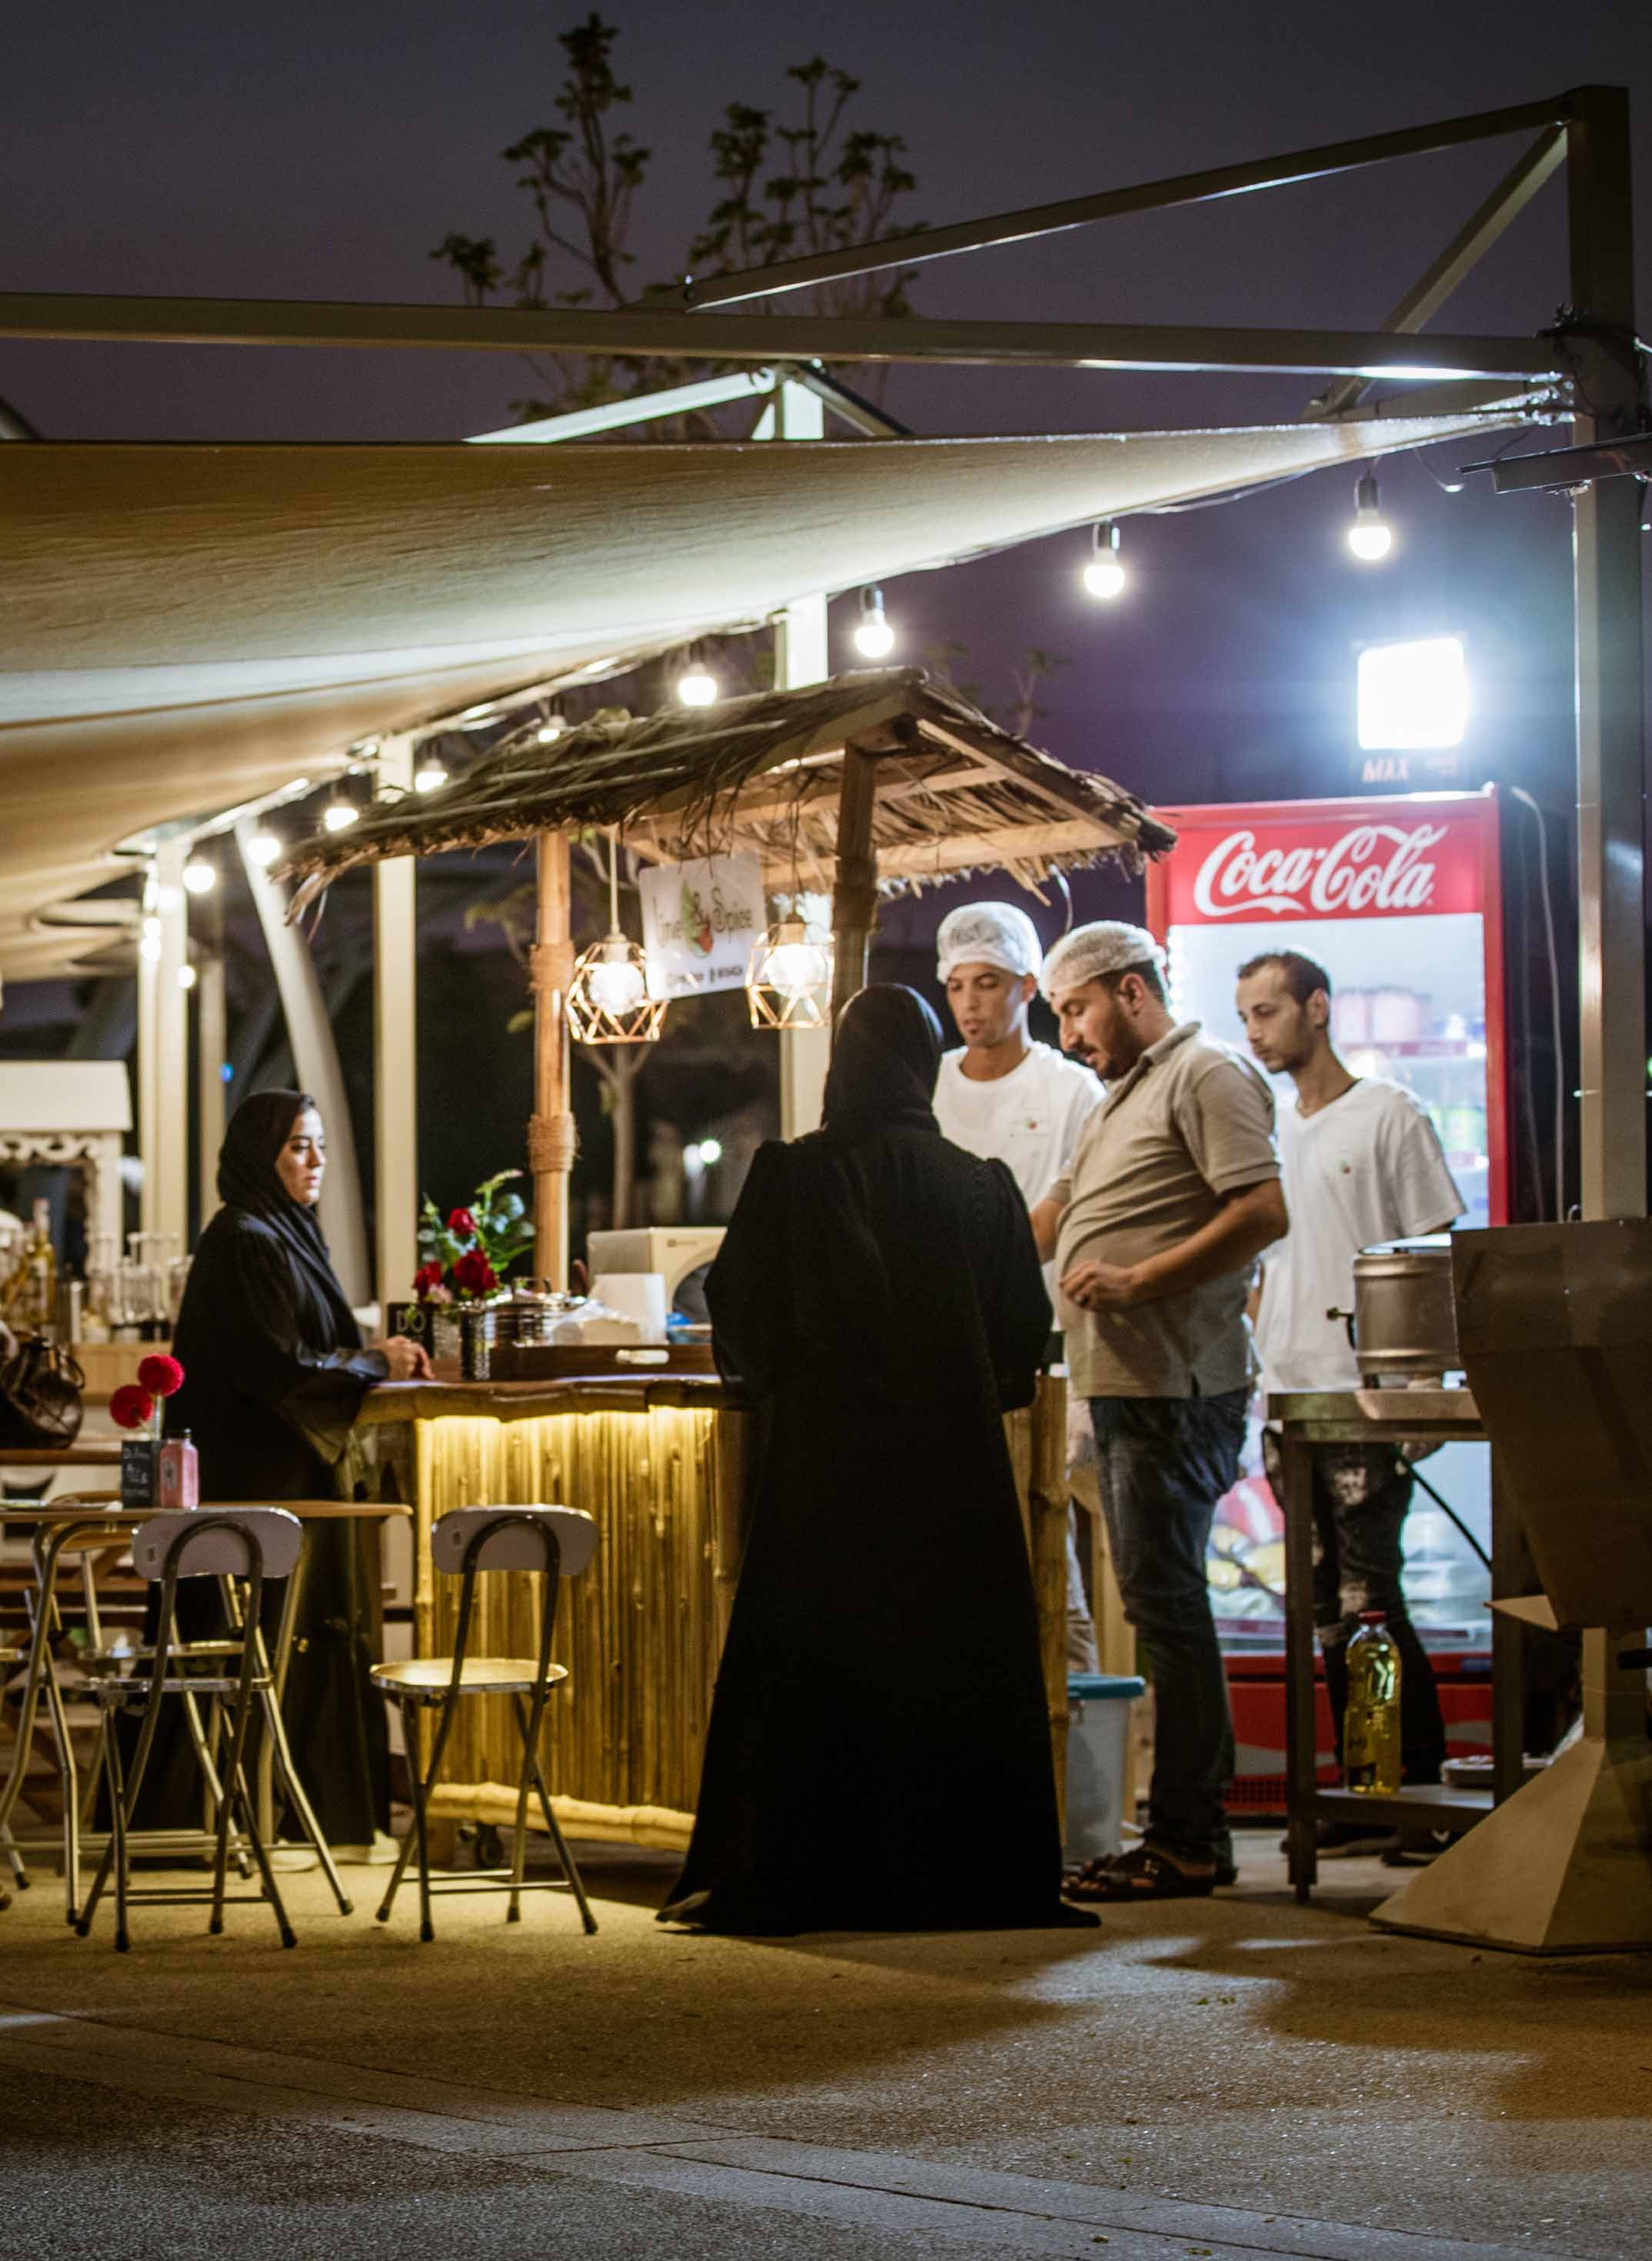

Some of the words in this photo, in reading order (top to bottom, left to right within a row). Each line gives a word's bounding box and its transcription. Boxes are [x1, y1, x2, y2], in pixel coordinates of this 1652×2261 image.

[1361, 757, 1409, 783] MAX
[1194, 824, 1448, 917] Coca-Cola
[711, 885, 753, 944] Spice
